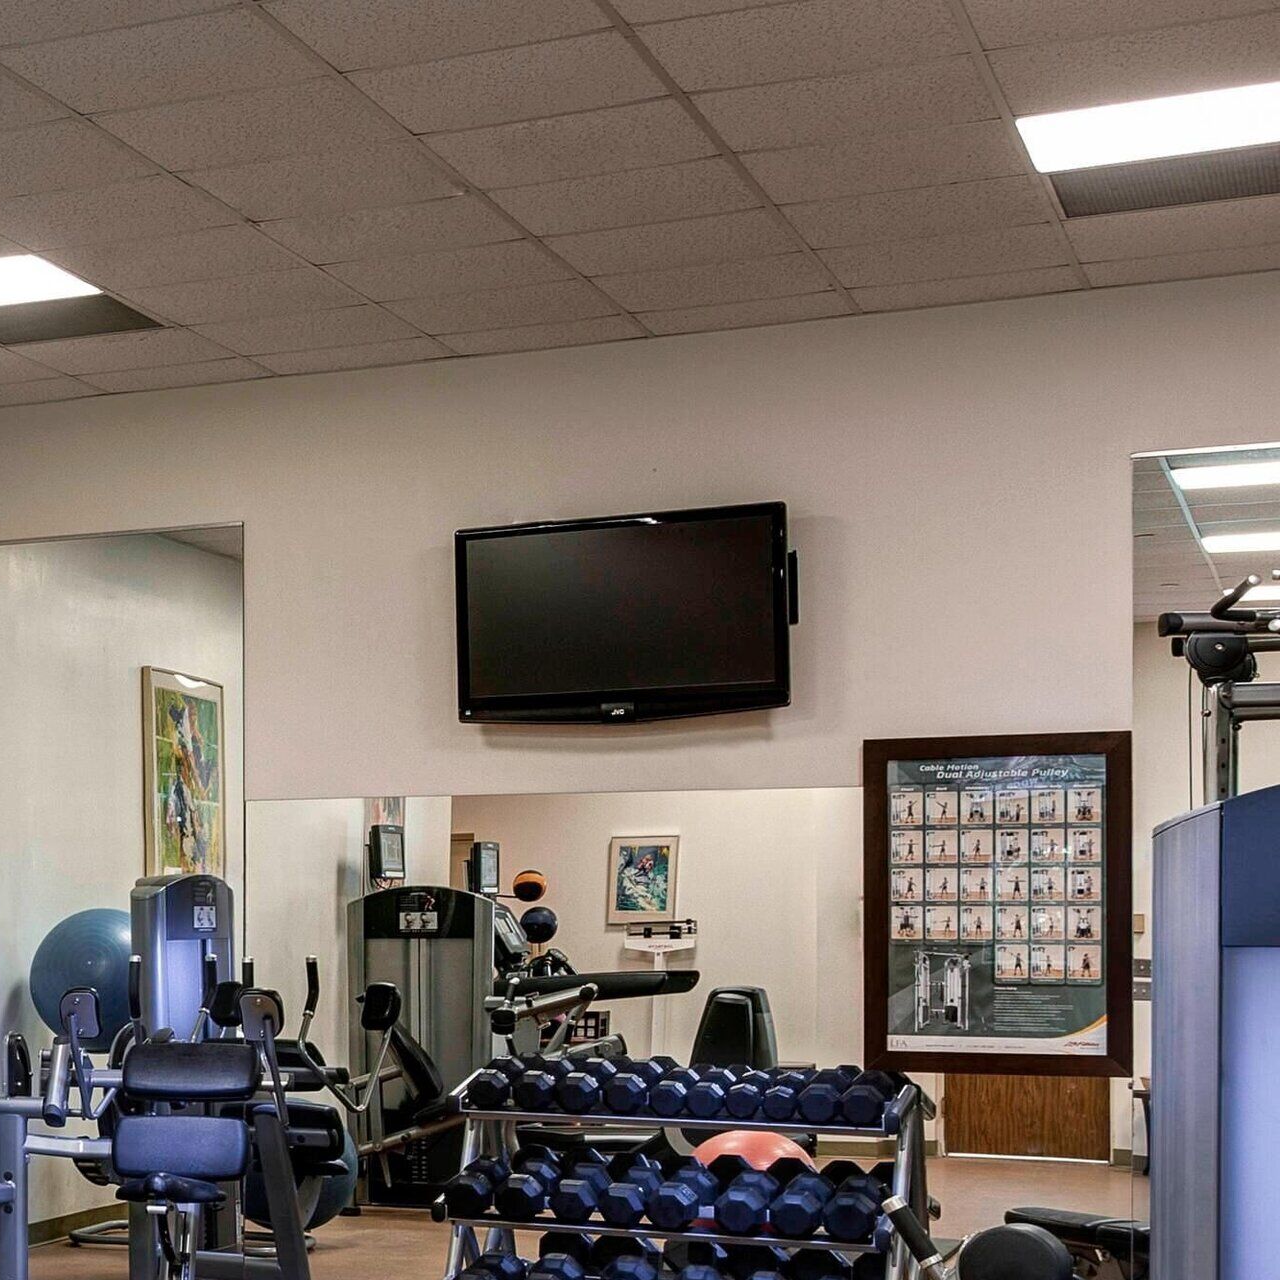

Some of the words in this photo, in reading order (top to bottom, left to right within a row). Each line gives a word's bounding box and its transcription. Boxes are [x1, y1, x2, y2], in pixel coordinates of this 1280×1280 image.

[936, 771, 963, 779] Dual
[965, 770, 1028, 780] Adjustable
[1031, 768, 1069, 778] Pulley
